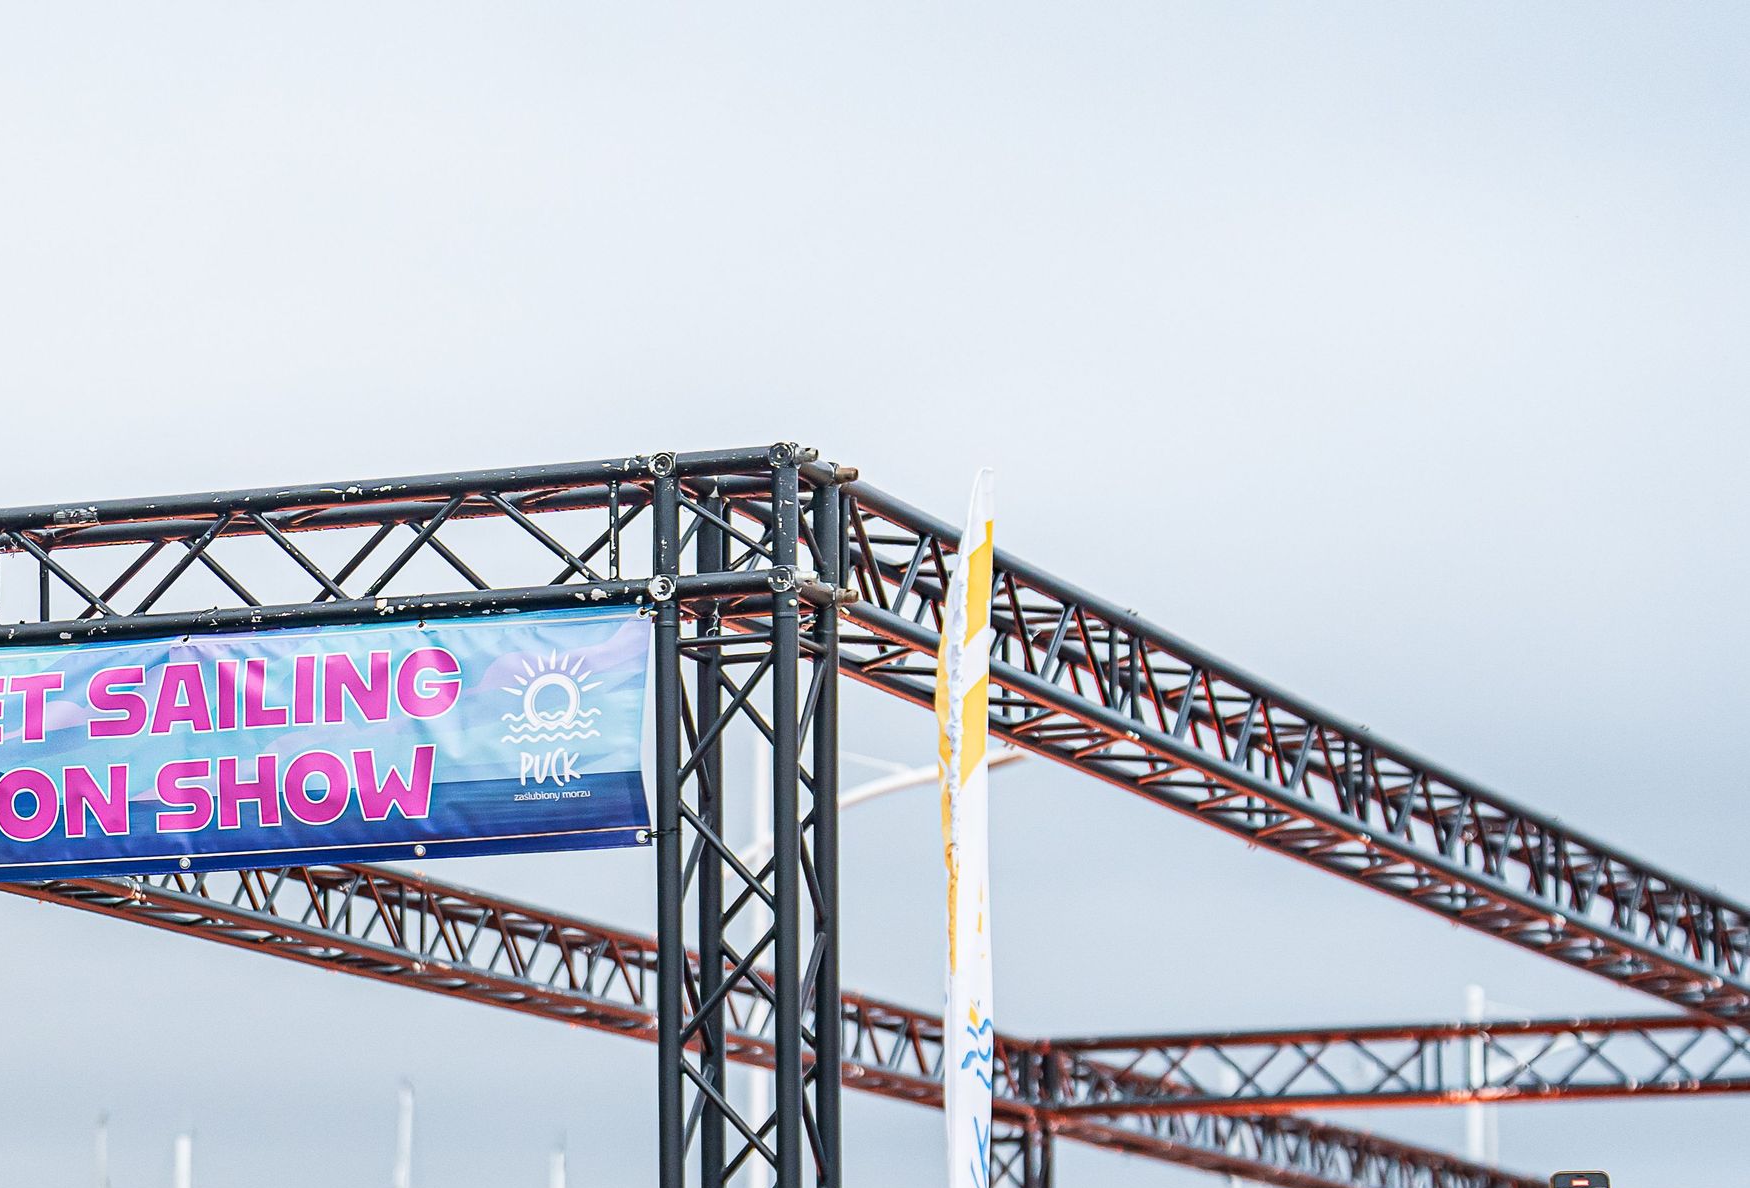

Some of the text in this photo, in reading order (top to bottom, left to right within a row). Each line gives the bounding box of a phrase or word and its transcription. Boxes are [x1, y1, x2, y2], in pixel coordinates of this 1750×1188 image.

[85, 645, 464, 740] SAILING
[154, 743, 437, 835] SHOW
[513, 790, 591, 802] zaślubiony morzu
[520, 747, 581, 787] PUCK
